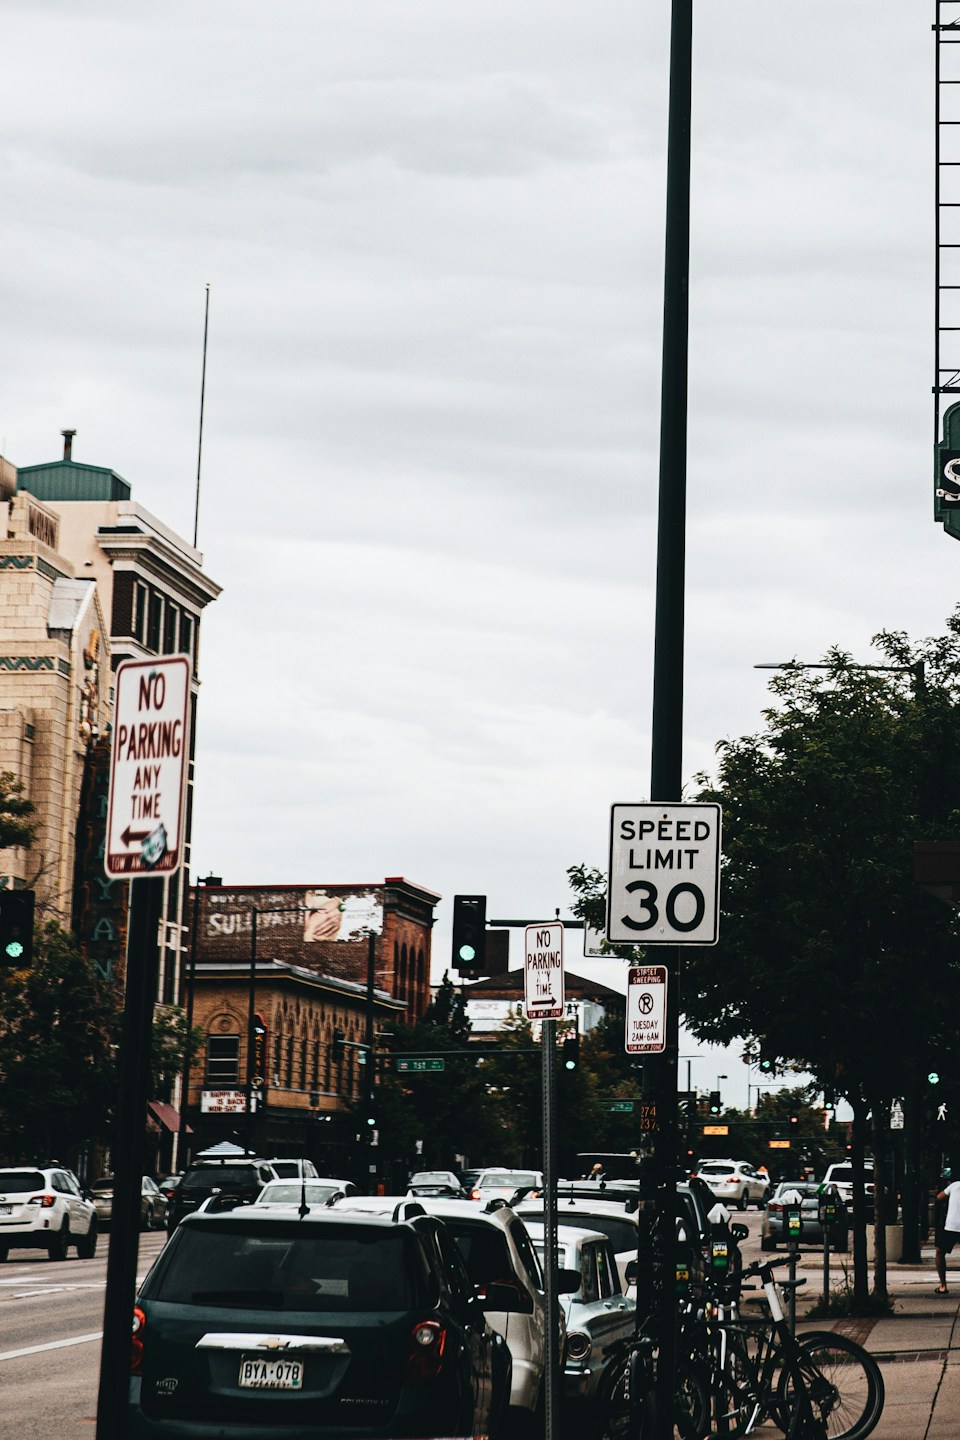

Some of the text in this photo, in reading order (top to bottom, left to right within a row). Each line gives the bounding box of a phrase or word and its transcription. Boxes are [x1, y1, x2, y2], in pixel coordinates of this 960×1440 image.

[138, 672, 166, 712] NO
[118, 719, 182, 762] PARKING
[133, 764, 161, 791] ANY
[131, 793, 161, 820] TIME
[620, 820, 711, 841] SPEED
[111, 856, 126, 871] TOW
[629, 849, 699, 870] LIMIT
[621, 880, 706, 933] 30
[536, 930, 551, 948] NO
[527, 951, 561, 971] PARKING
[632, 976, 661, 984] SWEEPING
[636, 968, 658, 976] STREET
[536, 983, 552, 996] TIME
[633, 1020, 659, 1030] TUESDAY
[631, 1032, 660, 1042] 2AM-6AM
